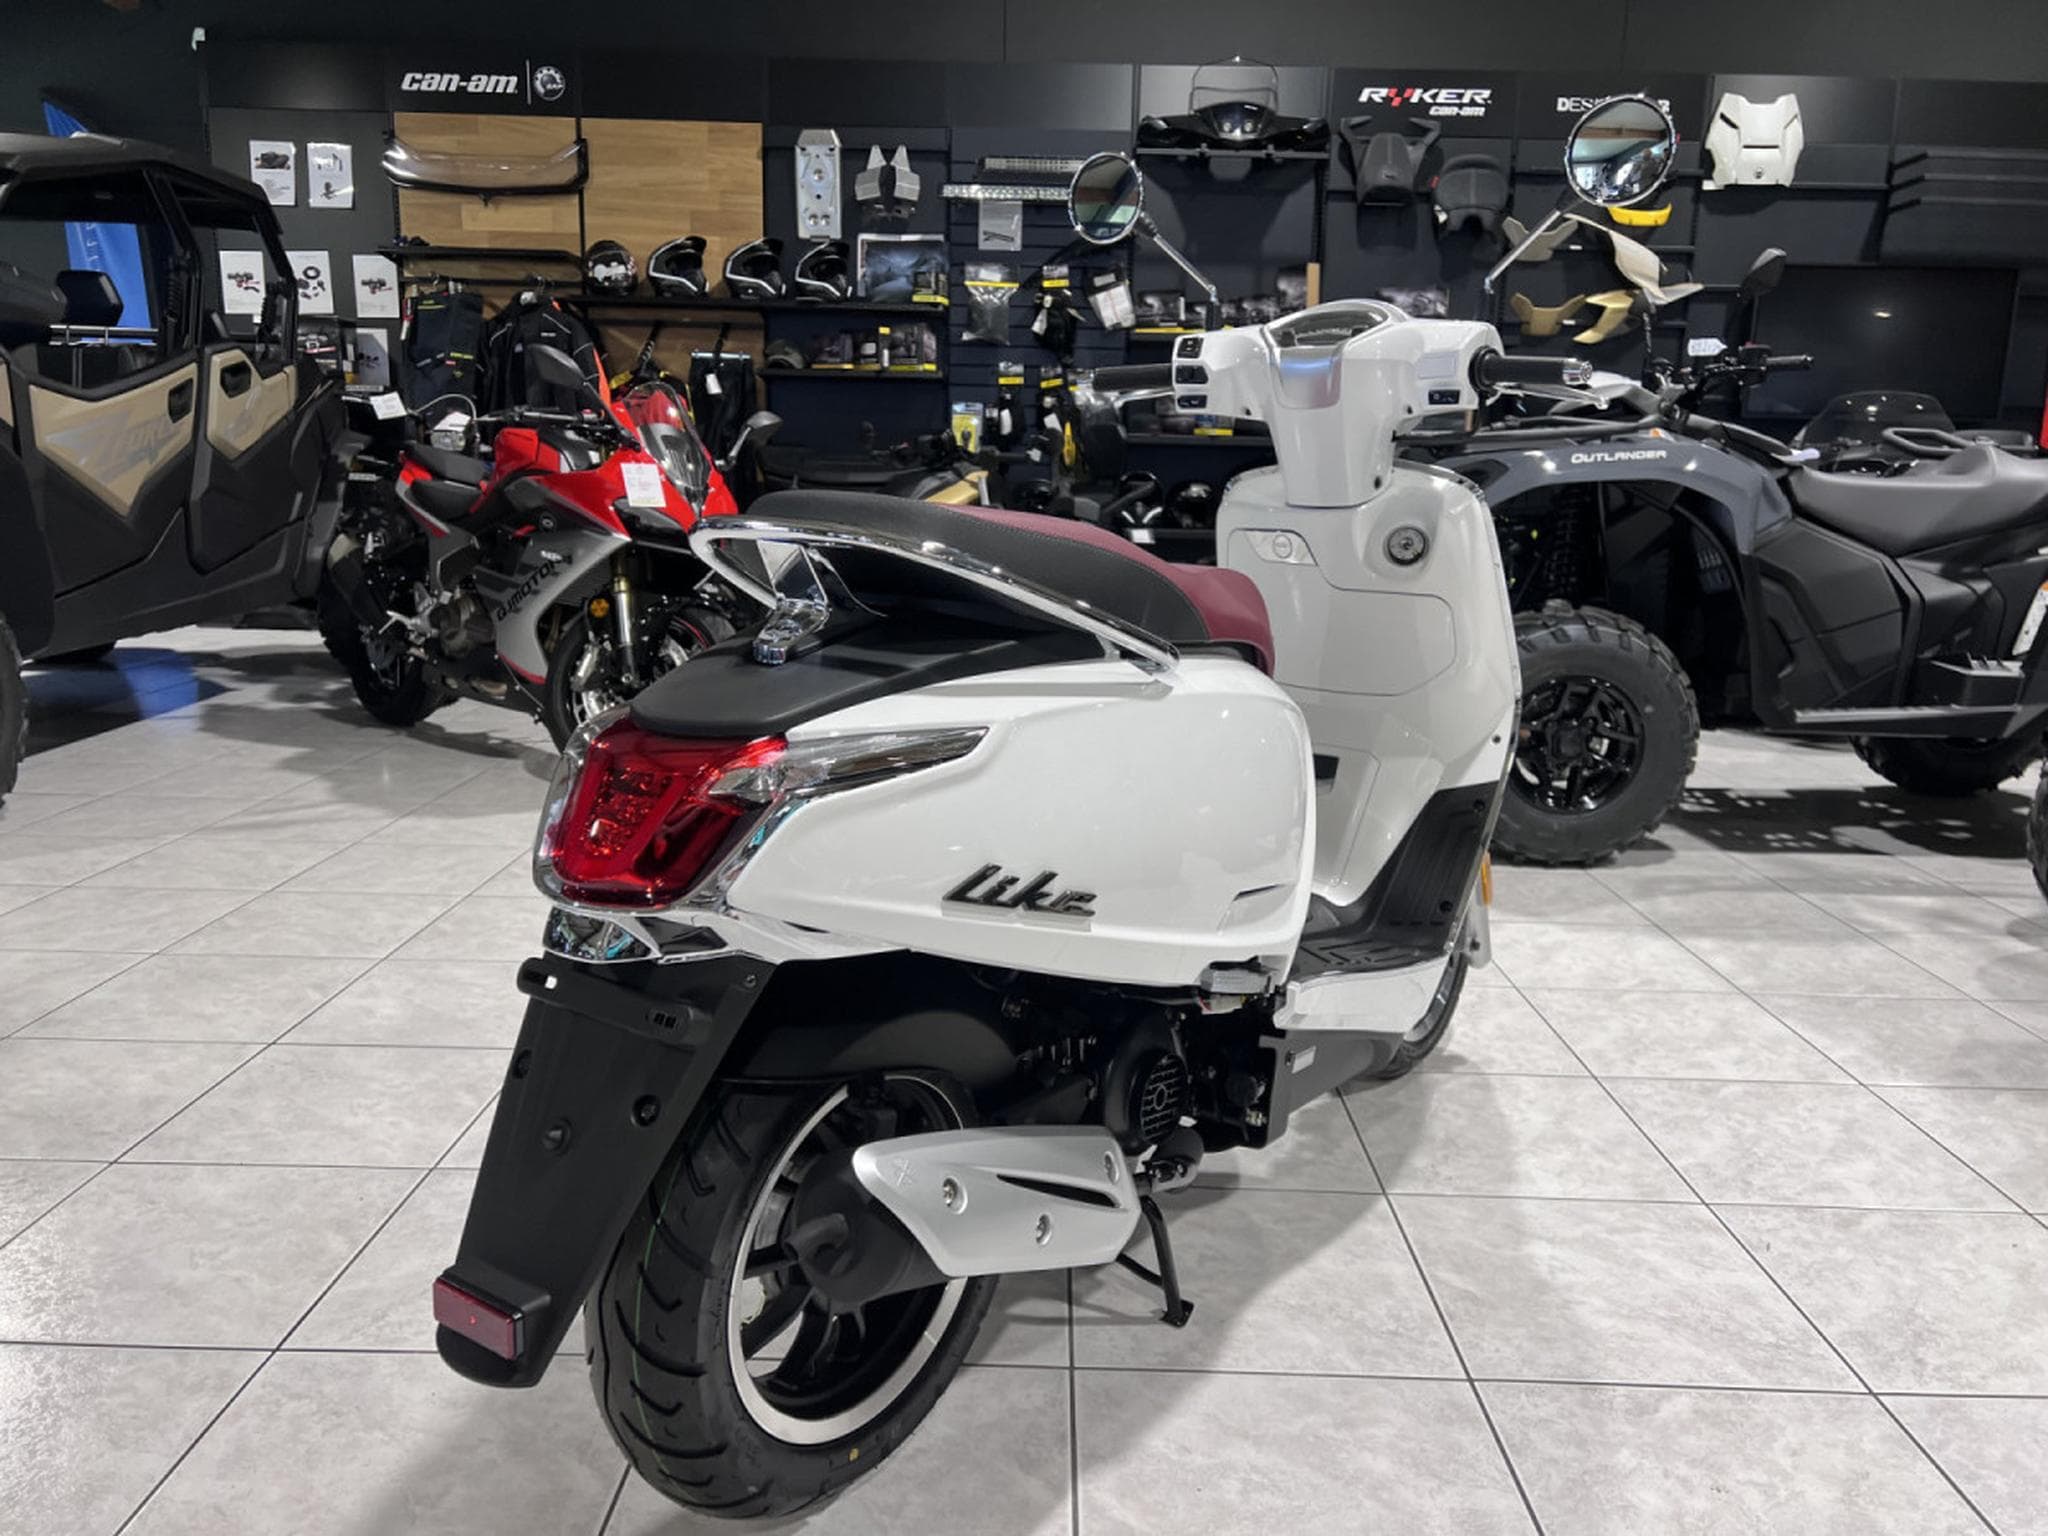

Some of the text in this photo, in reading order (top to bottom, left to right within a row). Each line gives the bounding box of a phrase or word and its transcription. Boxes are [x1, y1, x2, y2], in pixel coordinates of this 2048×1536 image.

[401, 72, 517, 93] can-am
[1358, 87, 1491, 107] RYKER
[1428, 105, 1486, 117] can-am
[1571, 450, 1667, 464] OUTLANDER
[942, 863, 1098, 917] Like
